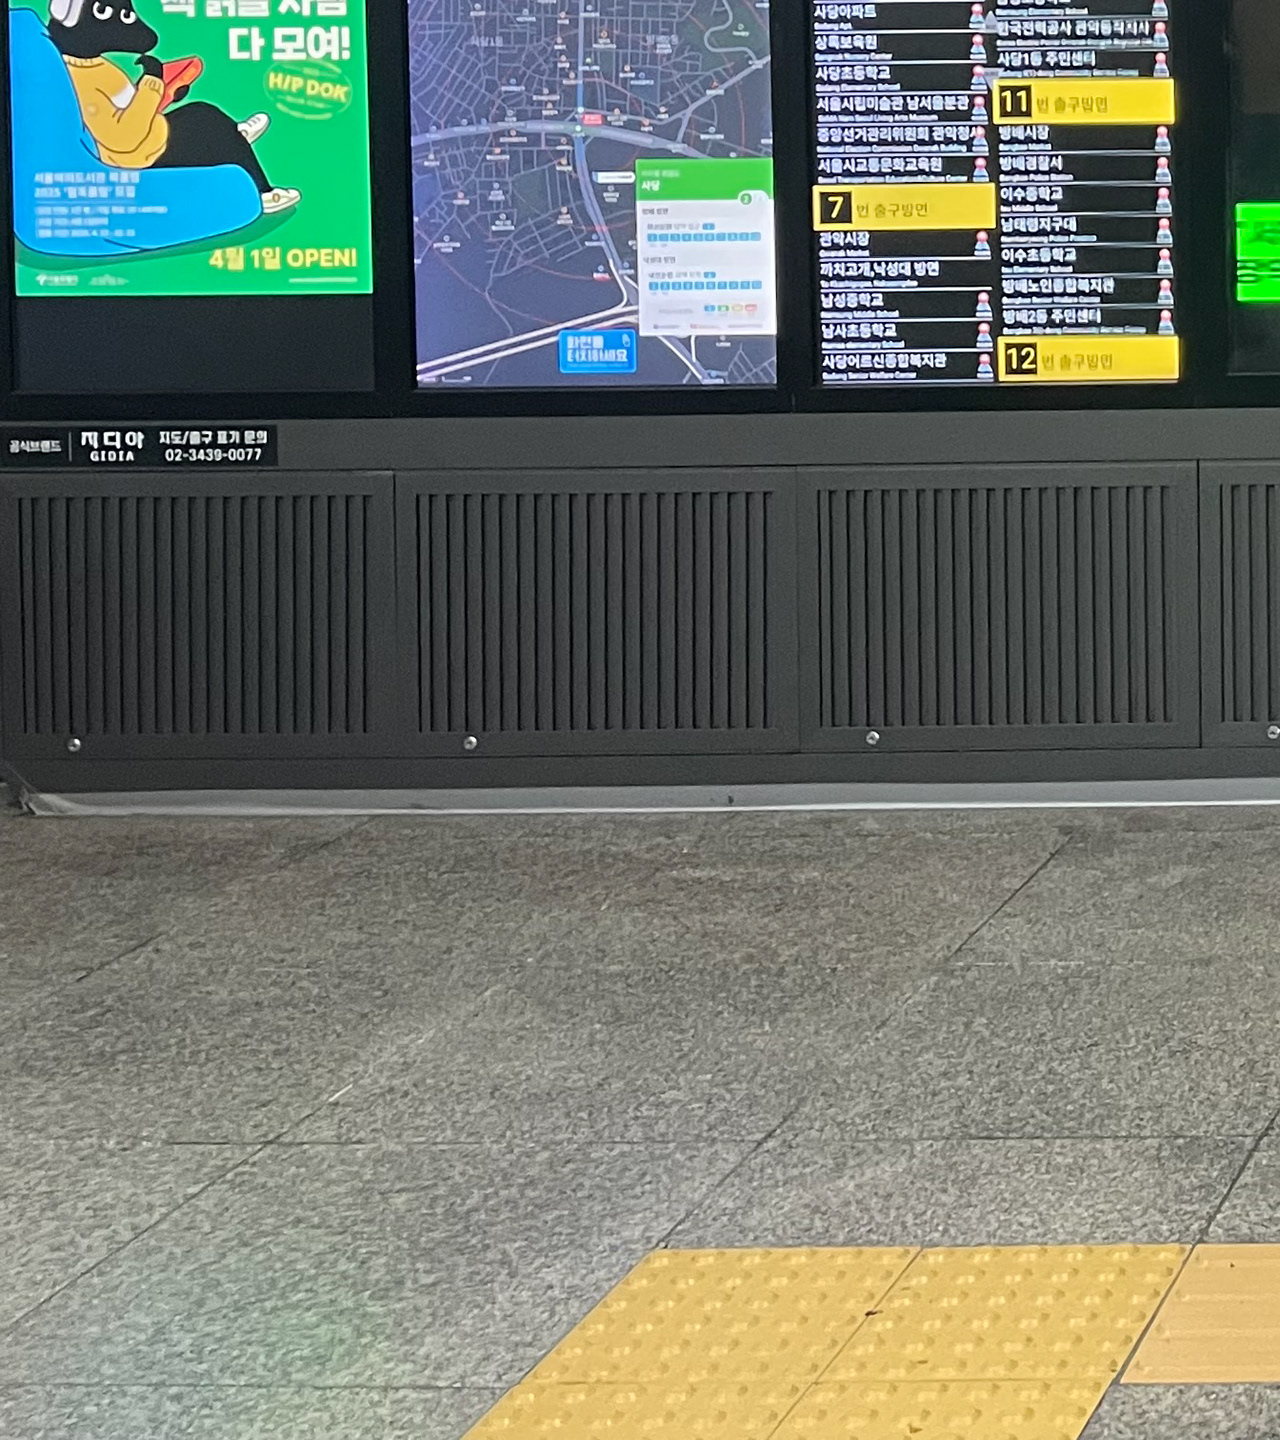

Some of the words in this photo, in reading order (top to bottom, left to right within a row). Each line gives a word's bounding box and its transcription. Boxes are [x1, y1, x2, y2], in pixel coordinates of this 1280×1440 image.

[814, 4, 877, 19] 사당아파트
[228, 27, 265, 61] 다
[272, 26, 351, 60] 모여!
[816, 66, 891, 81] 사당초등학교
[306, 79, 349, 103] DOK
[1001, 90, 1028, 112] 11
[816, 95, 904, 112] 서울시립미술관
[828, 197, 844, 218] 7
[209, 247, 244, 269] 4월
[250, 247, 281, 269] 1일
[286, 247, 358, 269] OPEN!
[1007, 347, 1036, 370] 12
